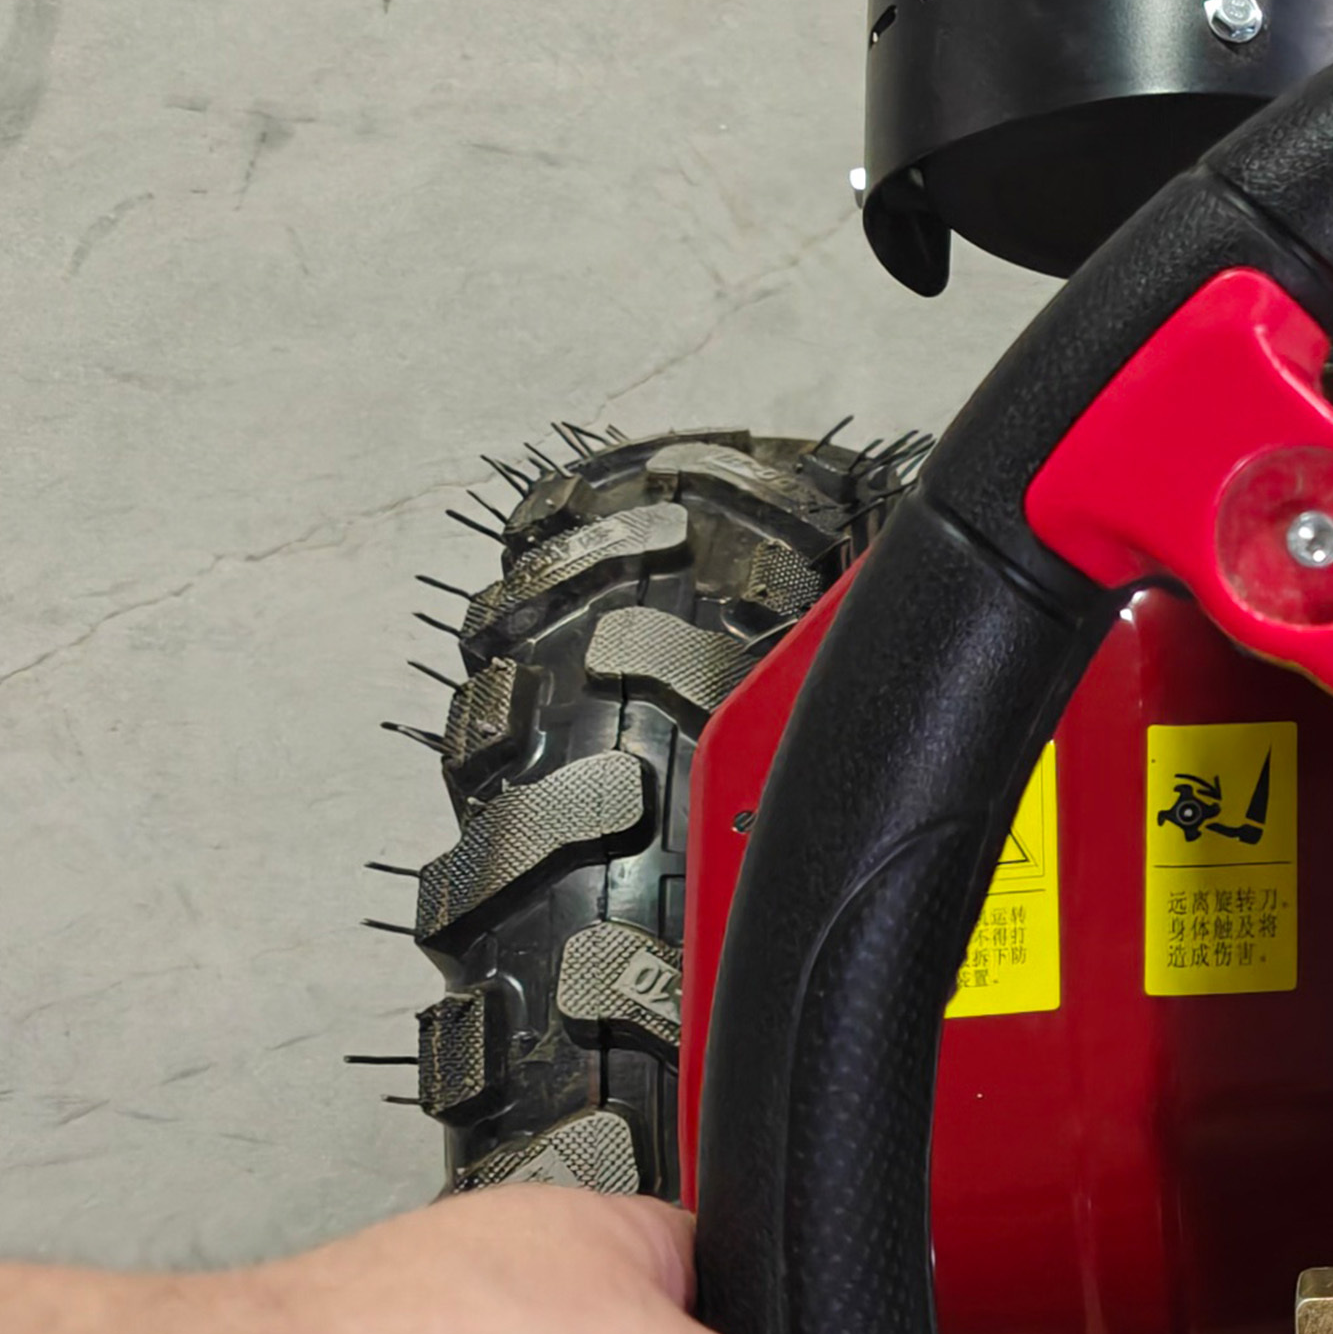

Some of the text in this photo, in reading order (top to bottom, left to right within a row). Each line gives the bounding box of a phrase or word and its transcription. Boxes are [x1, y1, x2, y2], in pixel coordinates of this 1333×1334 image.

[1168, 914, 1278, 943] 身体触及将
[961, 946, 1027, 968] 拆下防
